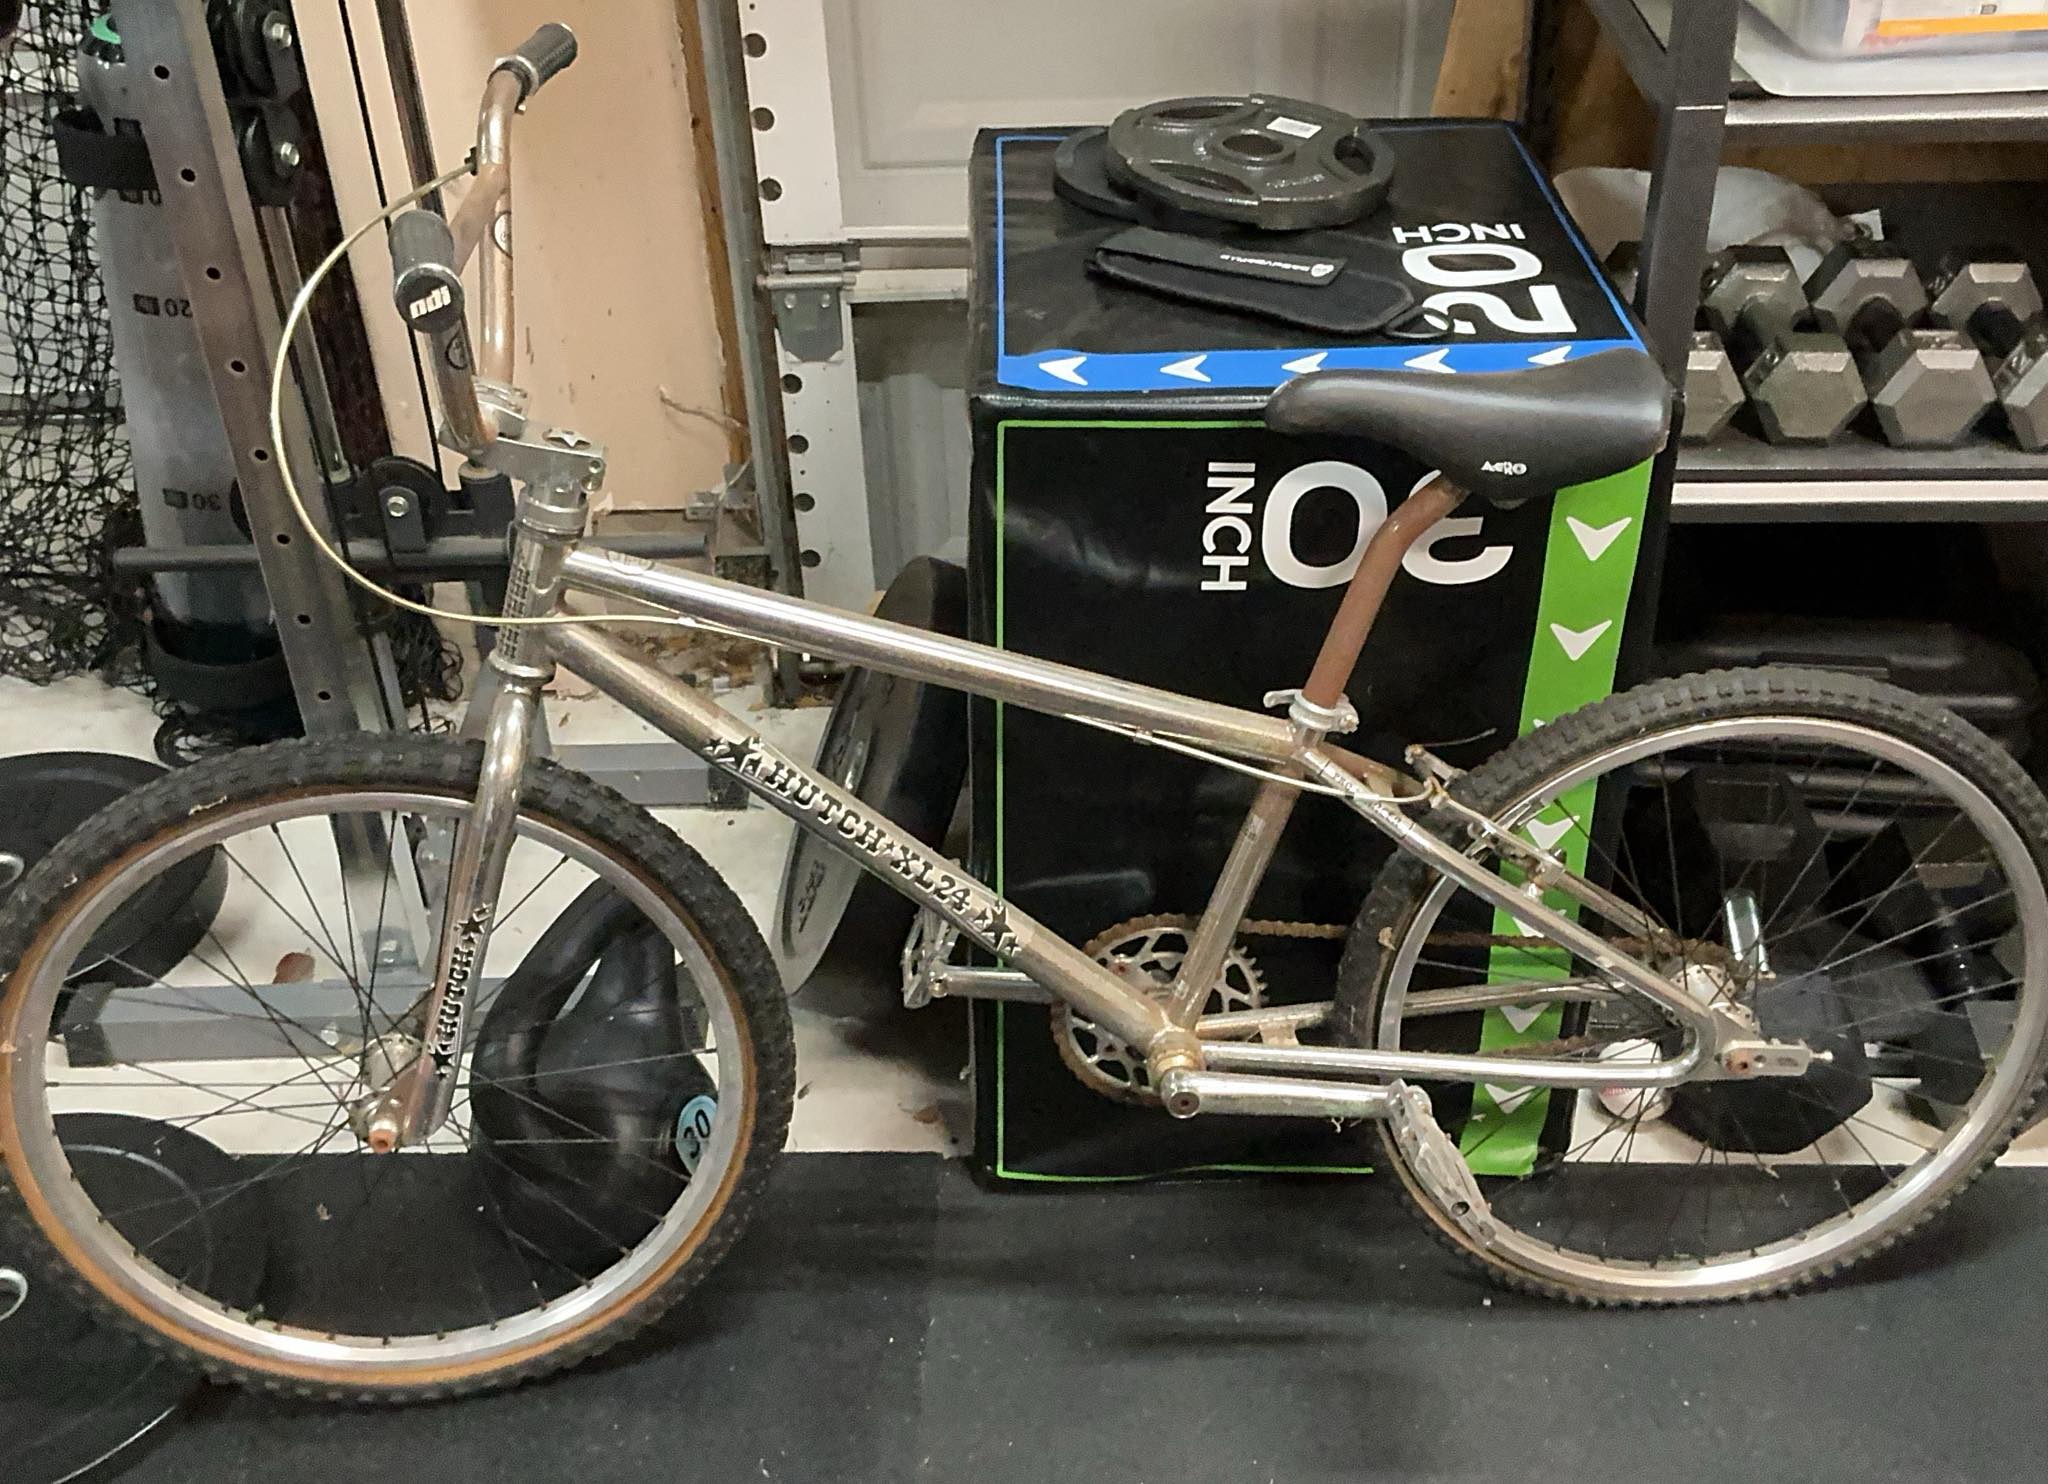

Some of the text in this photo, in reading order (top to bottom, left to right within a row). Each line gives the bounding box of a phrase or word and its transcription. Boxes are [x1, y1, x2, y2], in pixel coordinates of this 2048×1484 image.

[1392, 223, 1527, 244] INCH
[410, 285, 451, 319] odi
[1402, 243, 1577, 335] 20
[1481, 461, 1527, 475] AERO
[1201, 462, 1256, 591] INCH
[763, 761, 888, 857] HUTCH
[890, 844, 972, 914] XL24
[437, 946, 474, 1039] HUTCH
[684, 1109, 711, 1159] 30
